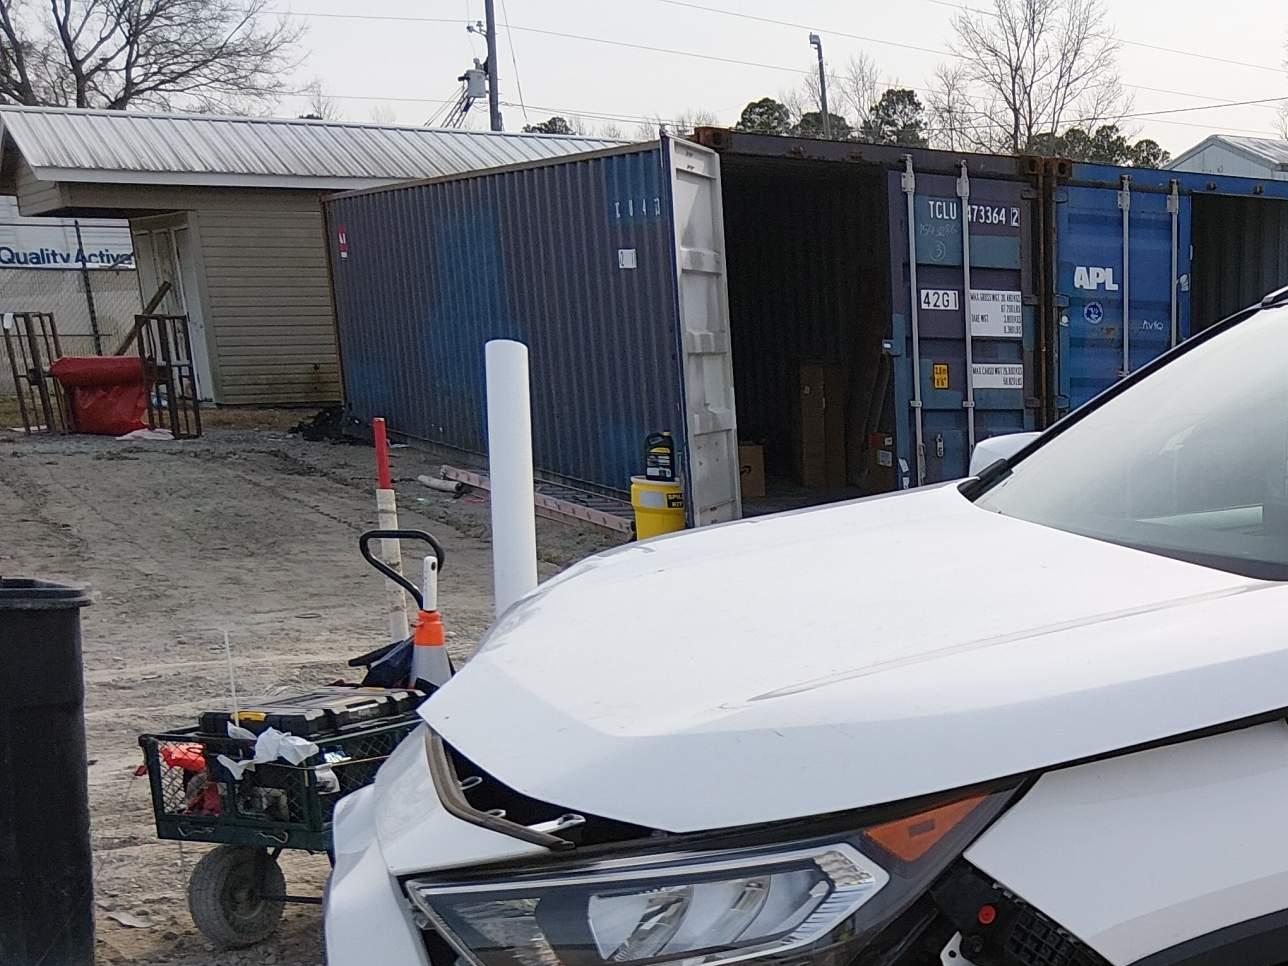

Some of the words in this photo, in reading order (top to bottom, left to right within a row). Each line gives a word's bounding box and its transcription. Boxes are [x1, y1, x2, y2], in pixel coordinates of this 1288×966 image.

[928, 201, 957, 220] TCLU
[0, 246, 71, 265] Quality
[75, 248, 133, 265] Active
[1074, 266, 1119, 291] APL
[923, 291, 957, 309] 42G1
